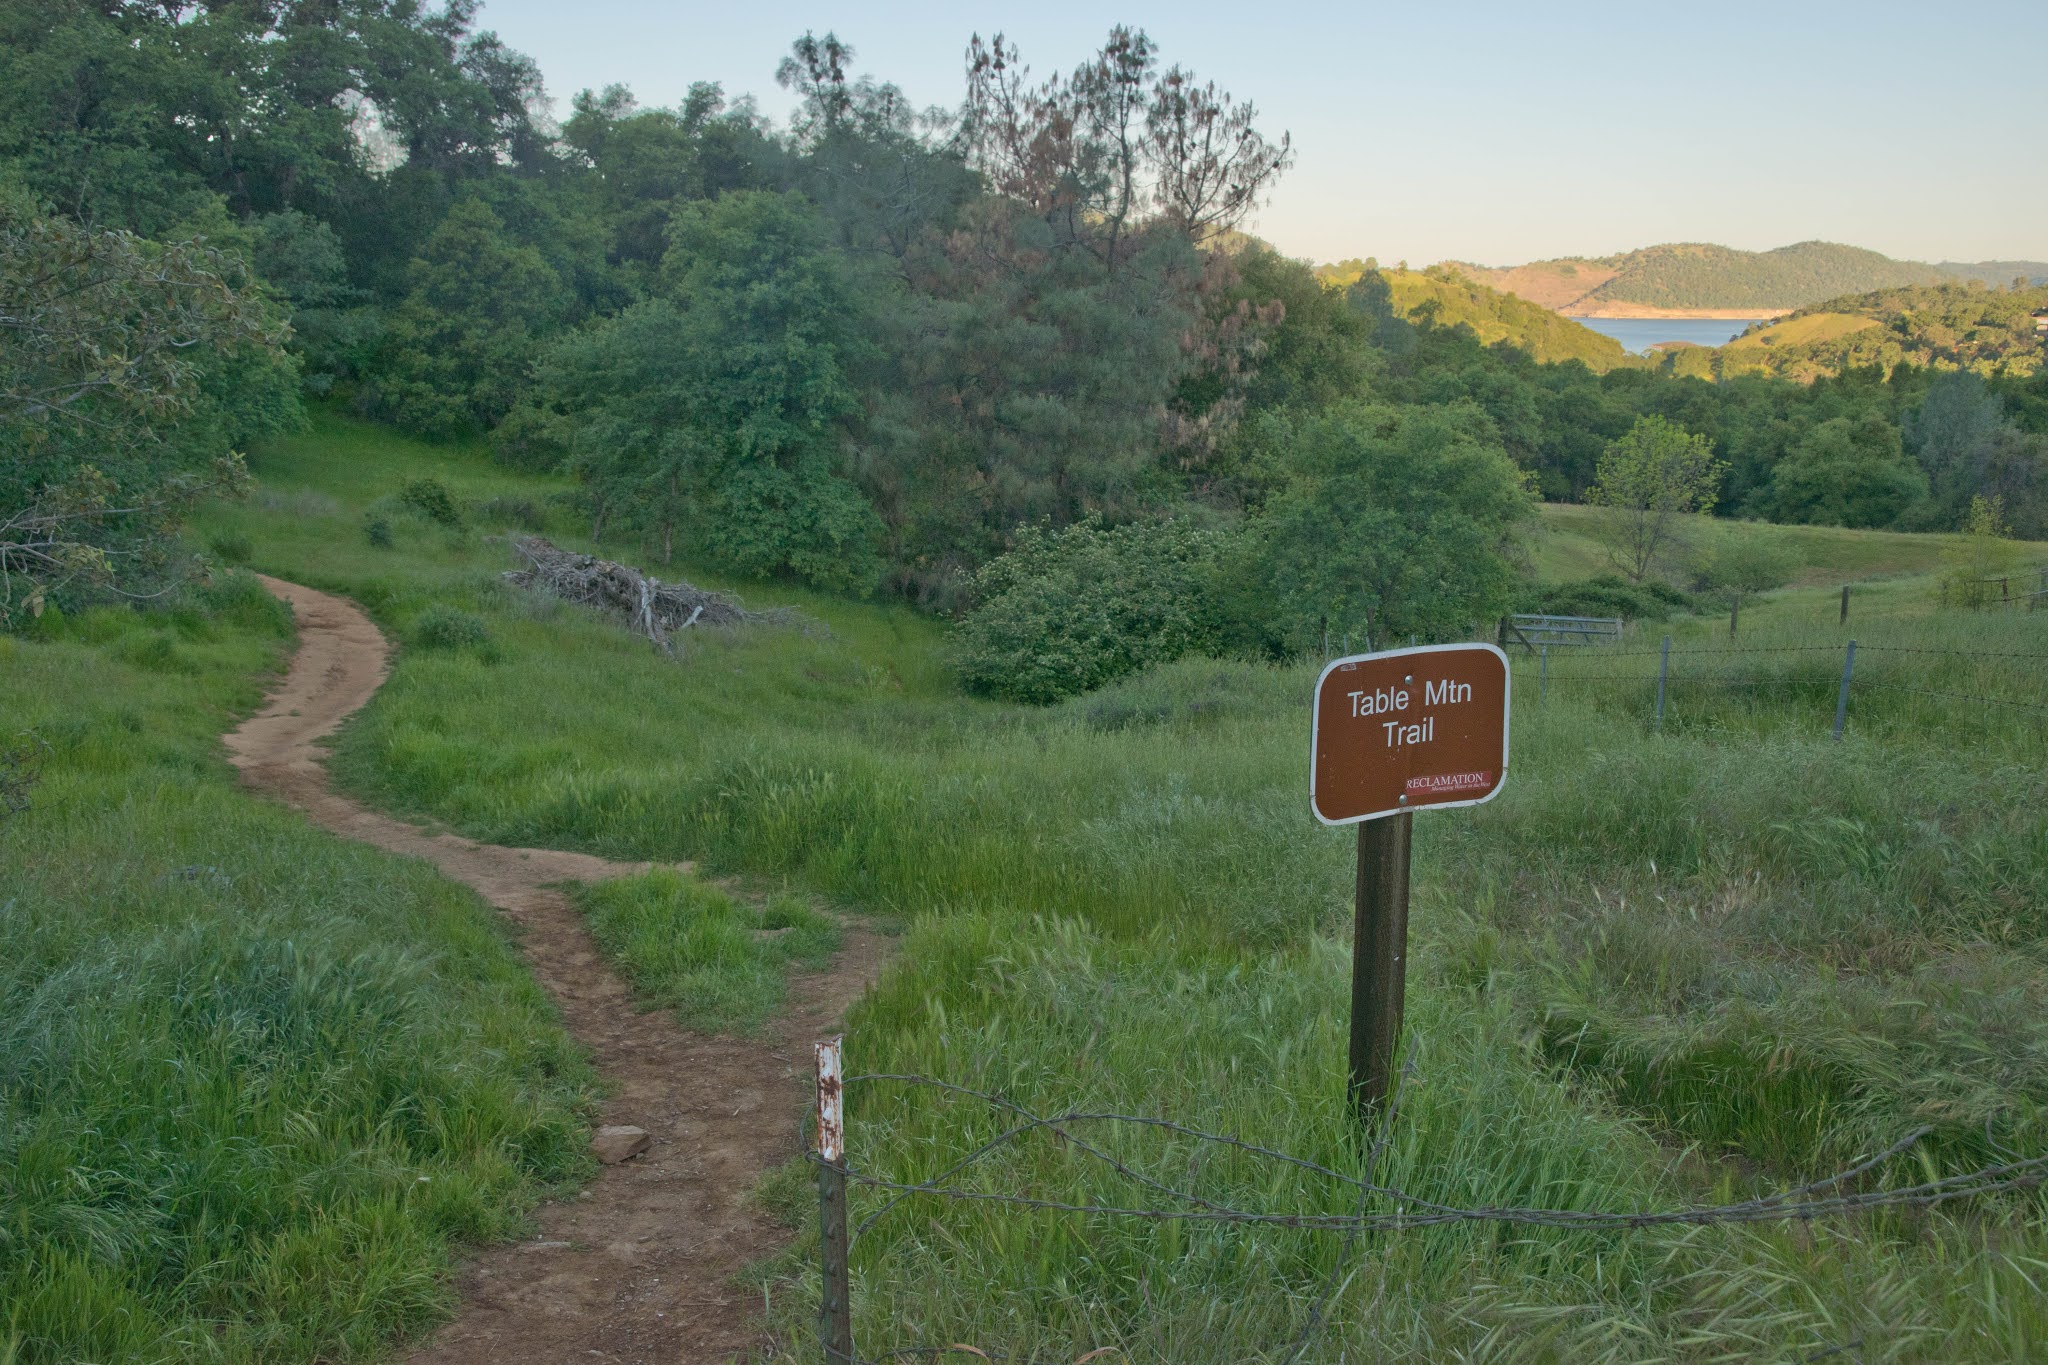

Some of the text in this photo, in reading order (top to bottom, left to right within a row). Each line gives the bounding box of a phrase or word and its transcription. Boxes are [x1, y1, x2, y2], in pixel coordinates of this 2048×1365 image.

[1347, 679, 1472, 718] Table Mtn
[1383, 716, 1434, 747] Trail
[1406, 773, 1484, 788] RECLAMATION
